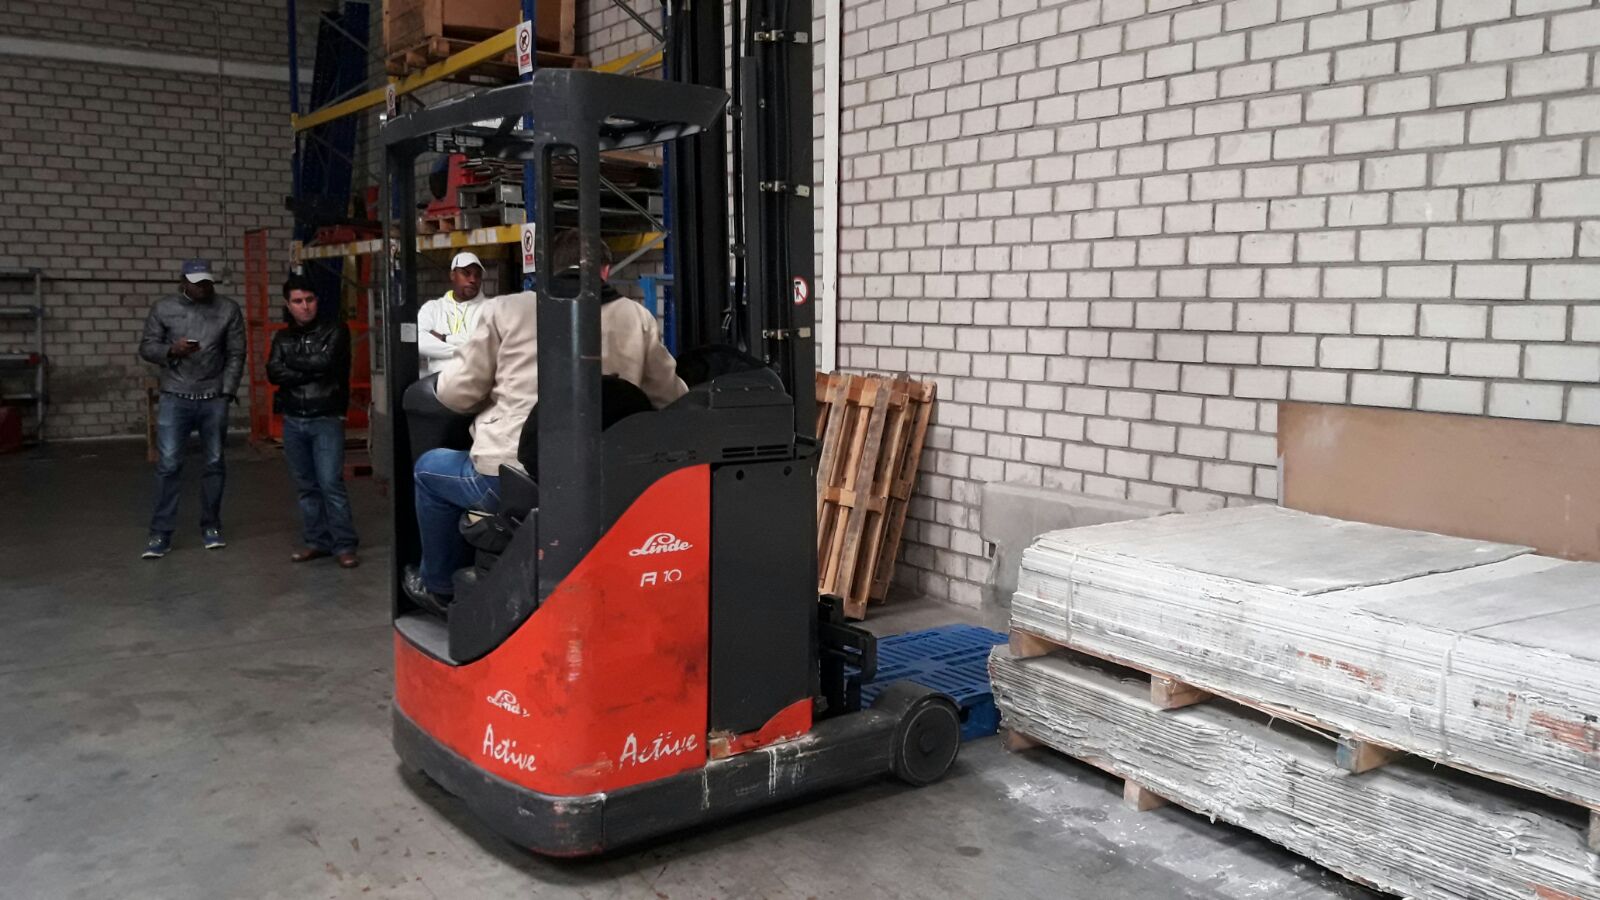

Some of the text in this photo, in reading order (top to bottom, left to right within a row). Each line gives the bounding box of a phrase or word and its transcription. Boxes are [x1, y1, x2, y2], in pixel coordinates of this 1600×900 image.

[628, 532, 693, 556] Linde
[663, 568, 682, 582] 10
[482, 723, 537, 772] Active
[619, 732, 698, 770] Active
